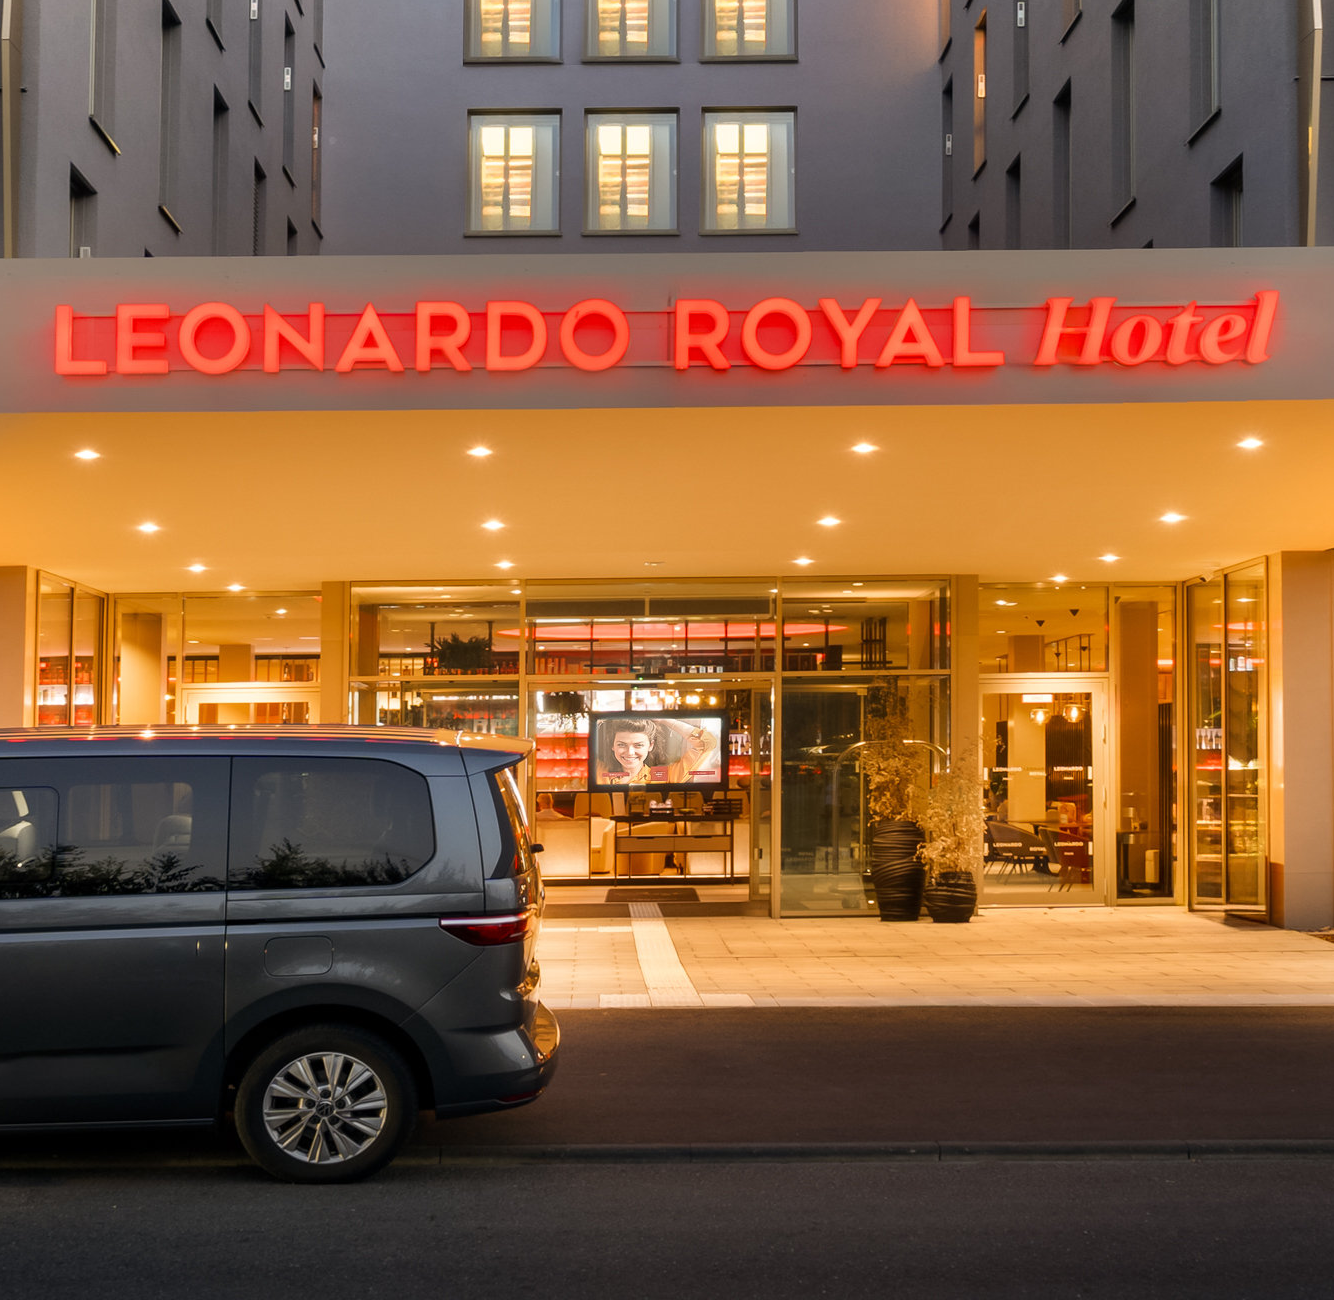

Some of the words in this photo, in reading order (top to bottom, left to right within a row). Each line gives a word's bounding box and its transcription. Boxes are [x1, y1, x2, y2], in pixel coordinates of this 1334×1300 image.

[55, 298, 630, 375] LEONARDO
[674, 296, 1005, 370] ROYAL
[1033, 290, 1280, 367] Hotel
